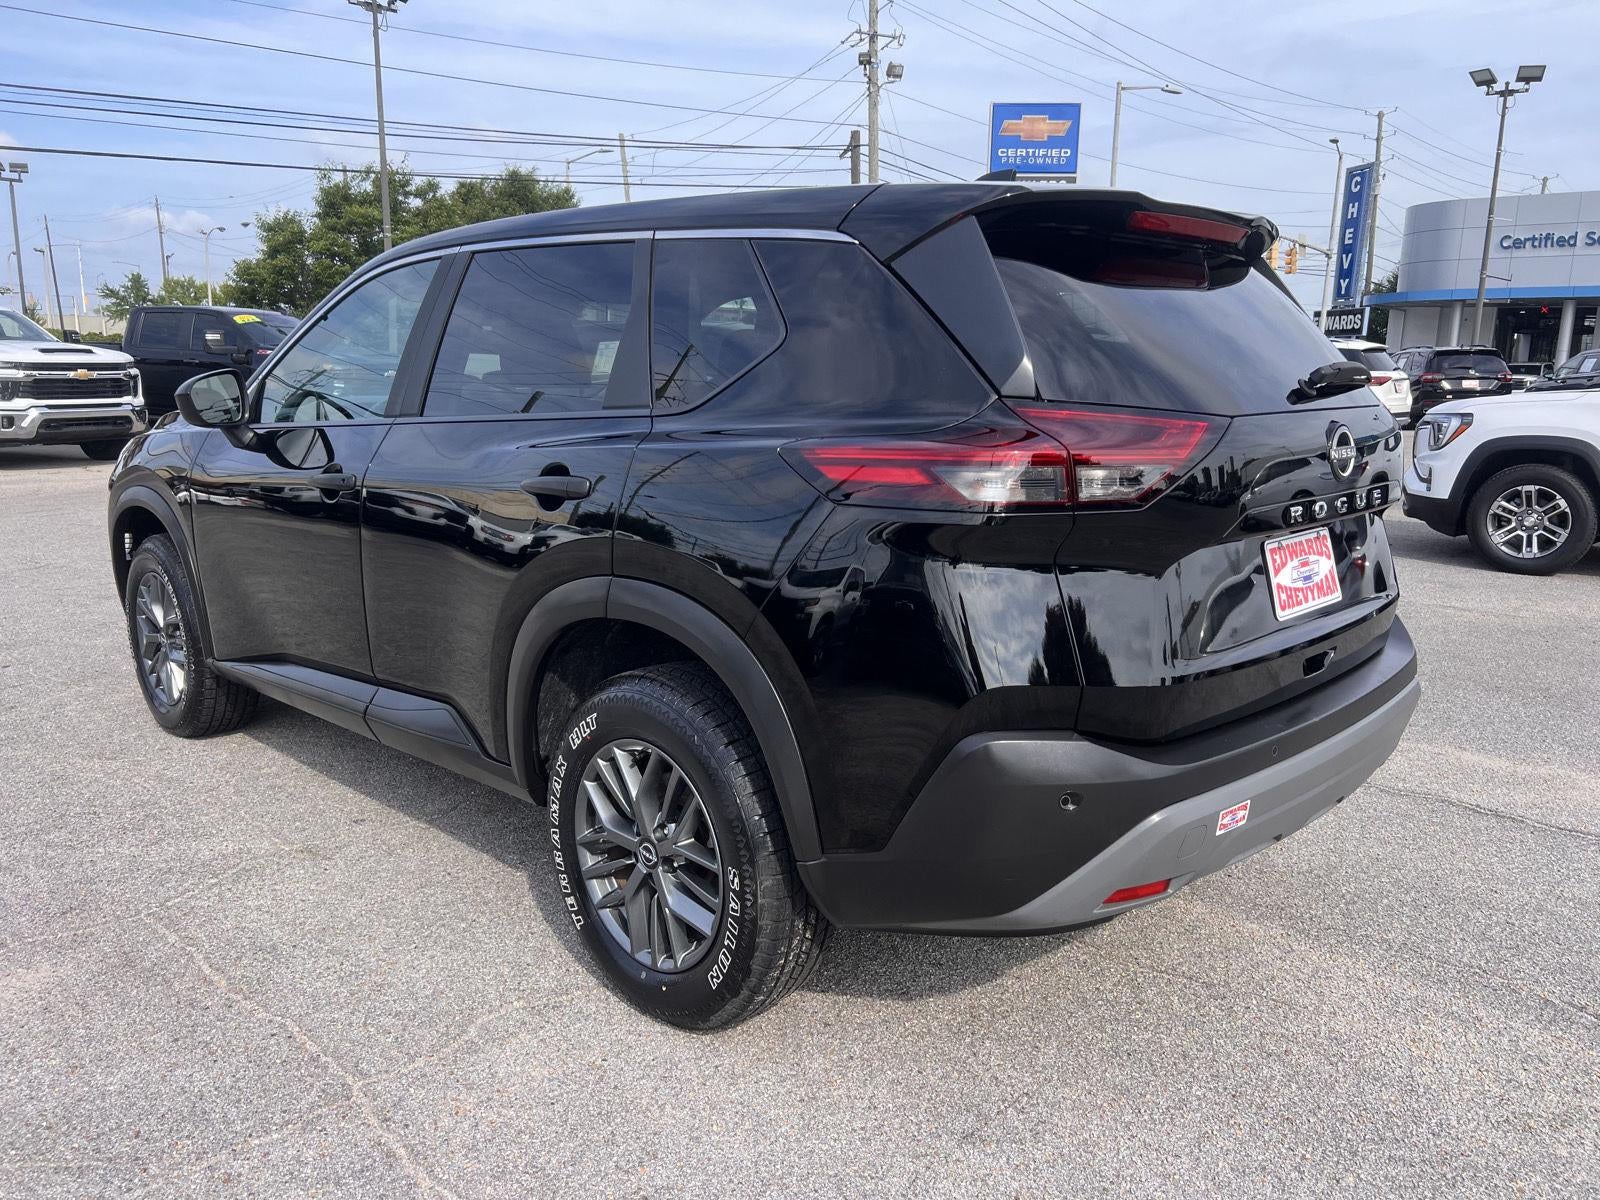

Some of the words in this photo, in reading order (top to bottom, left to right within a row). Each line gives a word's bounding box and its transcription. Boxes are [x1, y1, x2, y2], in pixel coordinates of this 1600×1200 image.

[998, 148, 1071, 157] CERTIFIED
[1339, 175, 1361, 295] CHEVY
[1500, 231, 1578, 250] Certified
[1584, 230, 1600, 247] S
[1313, 314, 1362, 331] EWARDS
[1331, 448, 1356, 460] NISSA
[1289, 489, 1382, 524] ROGUE
[1268, 533, 1332, 578] EDWARDS
[1275, 565, 1338, 612] CHEVYMAN
[568, 712, 598, 751] HLT
[707, 866, 741, 990] SAILUN
